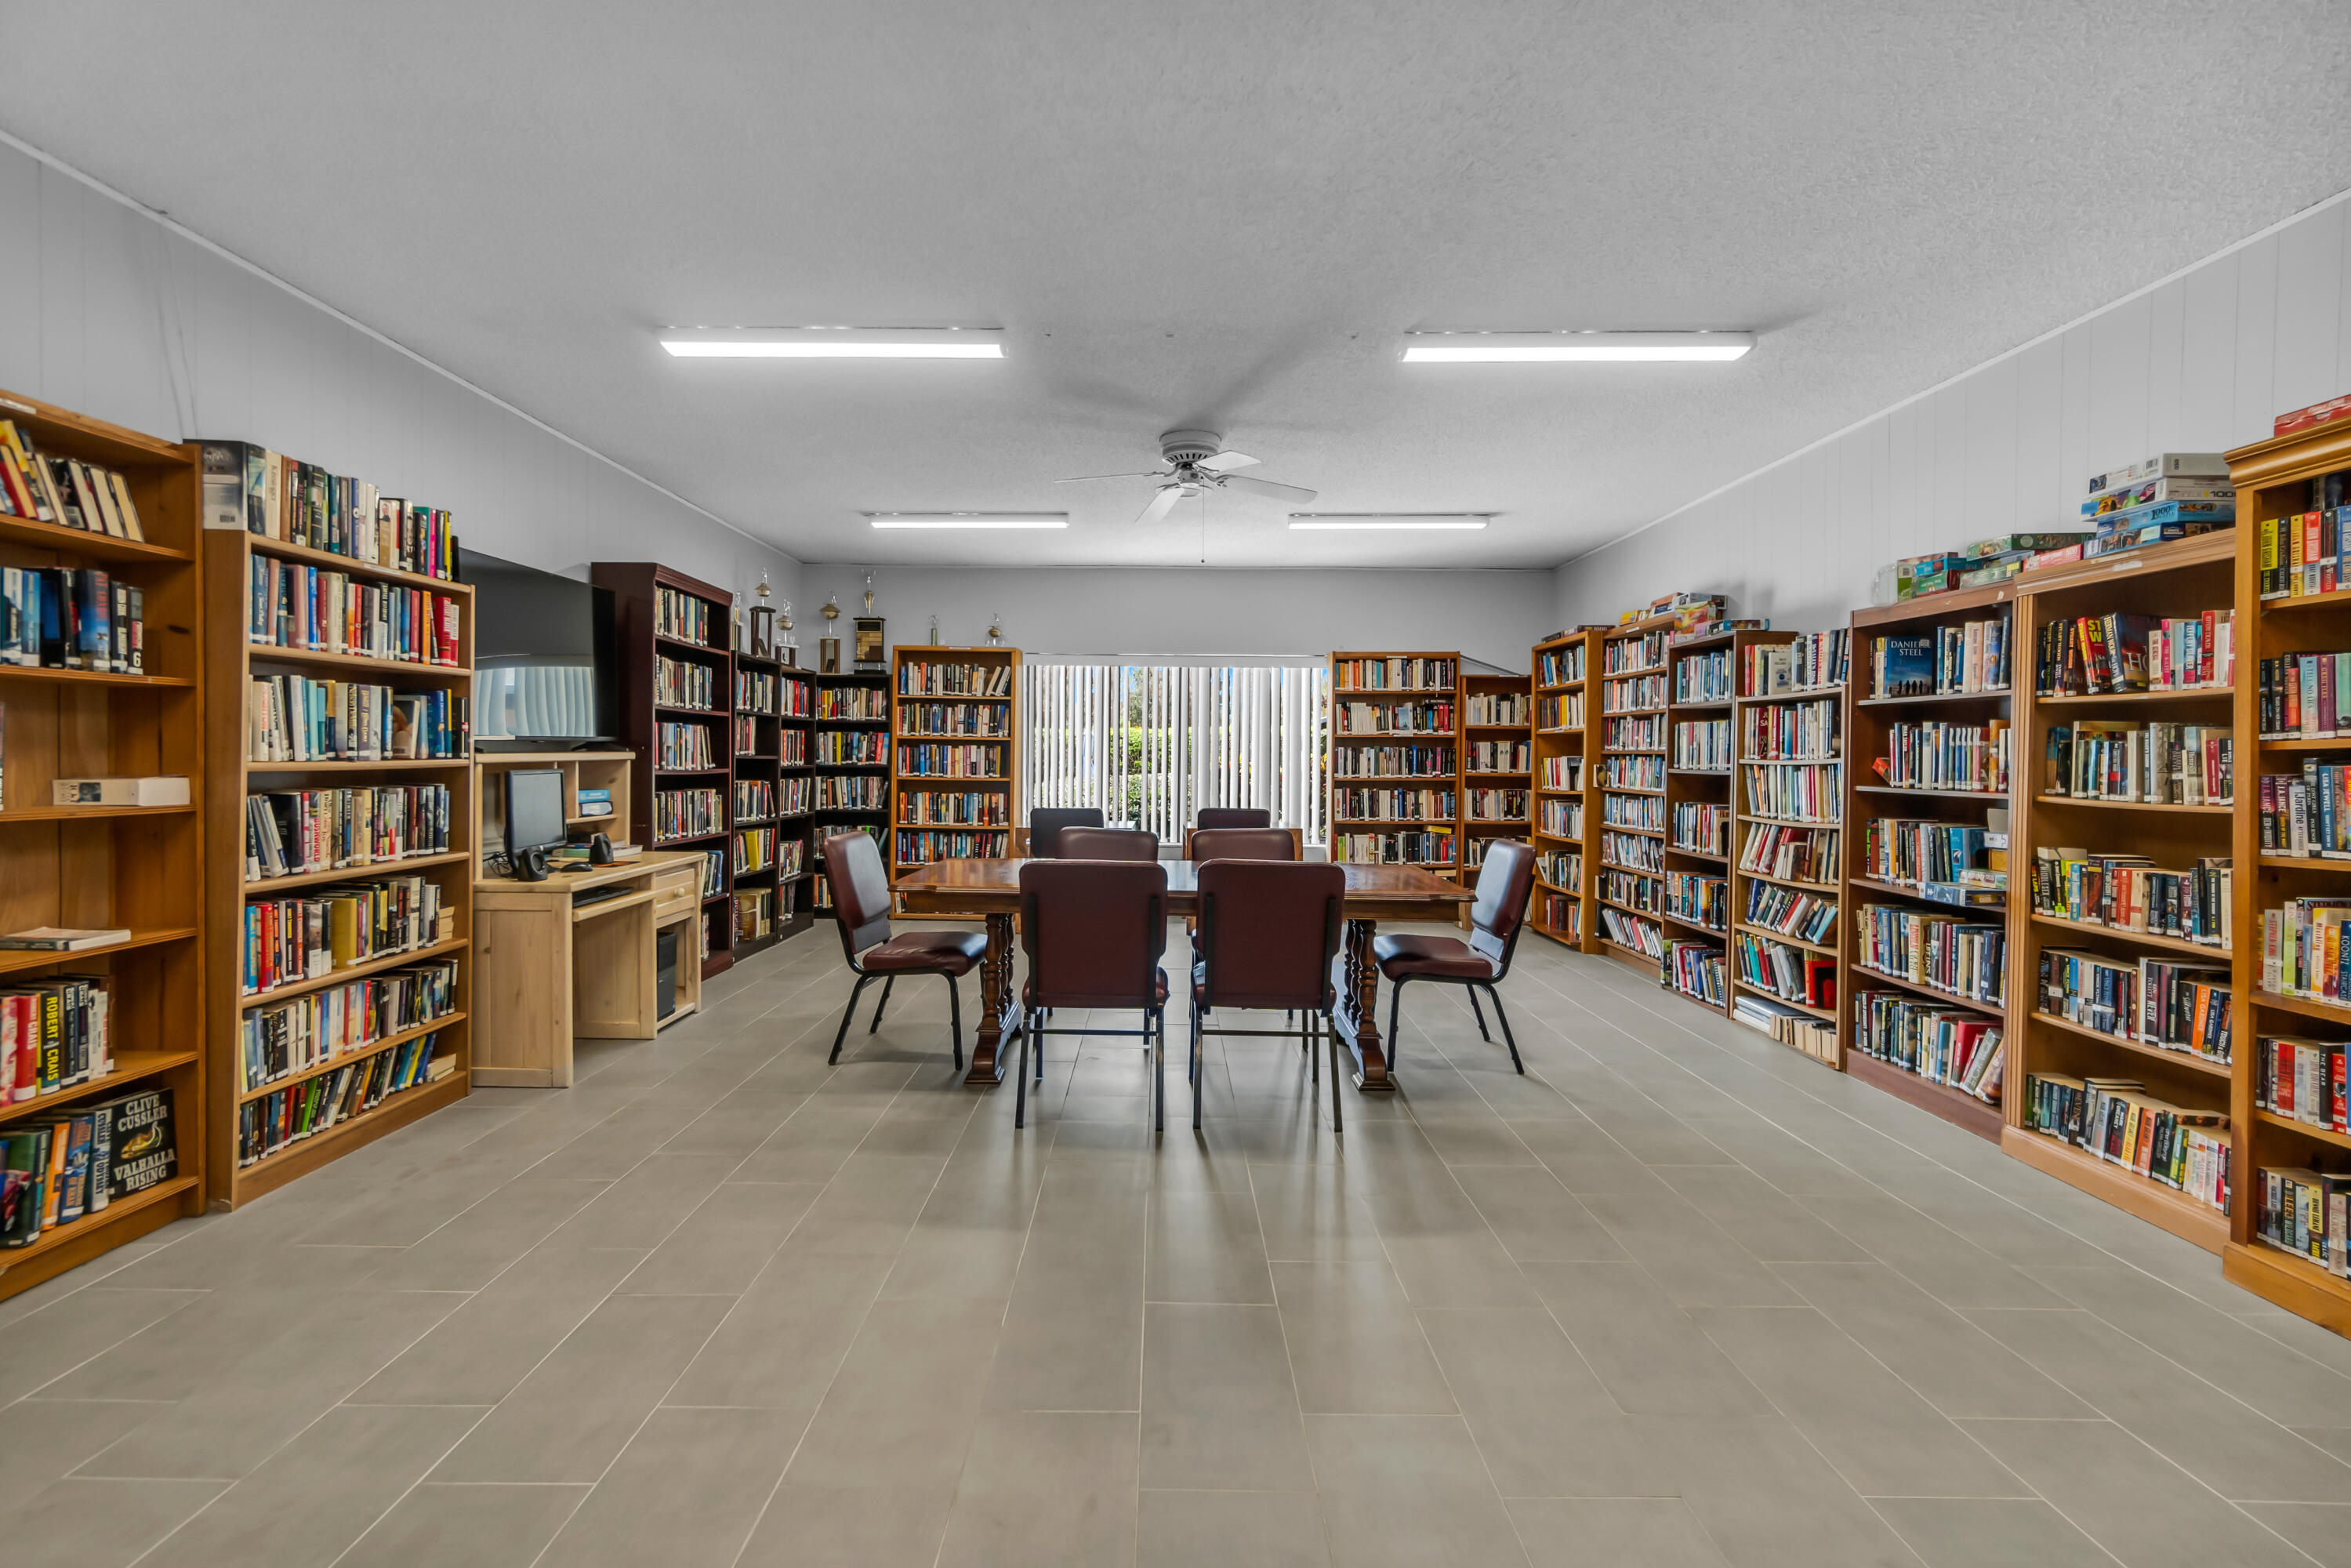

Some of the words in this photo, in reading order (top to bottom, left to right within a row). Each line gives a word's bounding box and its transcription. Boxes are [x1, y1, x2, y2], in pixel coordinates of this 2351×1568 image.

[269, 465, 278, 502] Kissinger
[2151, 505, 2171, 521] 1000
[2104, 616, 2113, 640] HERMAN
[132, 651, 143, 668] 6
[2306, 685, 2314, 695] NO
[2262, 796, 2273, 814] JANCE
[2277, 796, 2287, 812] JANCE
[2294, 793, 2305, 825] Jardine
[2322, 788, 2331, 812] JEWELL
[2040, 866, 2049, 896] MIDDLESEX
[2269, 919, 2278, 942] STEPHEN
[2313, 922, 2323, 951] Mischling
[2341, 935, 2349, 966] KOONTZ
[46, 996, 59, 1039] ROBERT
[2146, 1000, 2157, 1022] NEVER
[27, 1021, 38, 1050] CRAIS
[2219, 1030, 2228, 1047] TOUCH
[47, 1049, 59, 1080] CRAIS
[118, 1105, 168, 1132] CUSSLER
[125, 1094, 160, 1116] CLIVE
[2113, 1105, 2121, 1129] GREANEY
[97, 1112, 107, 1145] CUSSLER
[96, 1162, 105, 1195] ODYSSEY
[113, 1148, 176, 1182] VALHALLA
[125, 1165, 168, 1192] RISING
